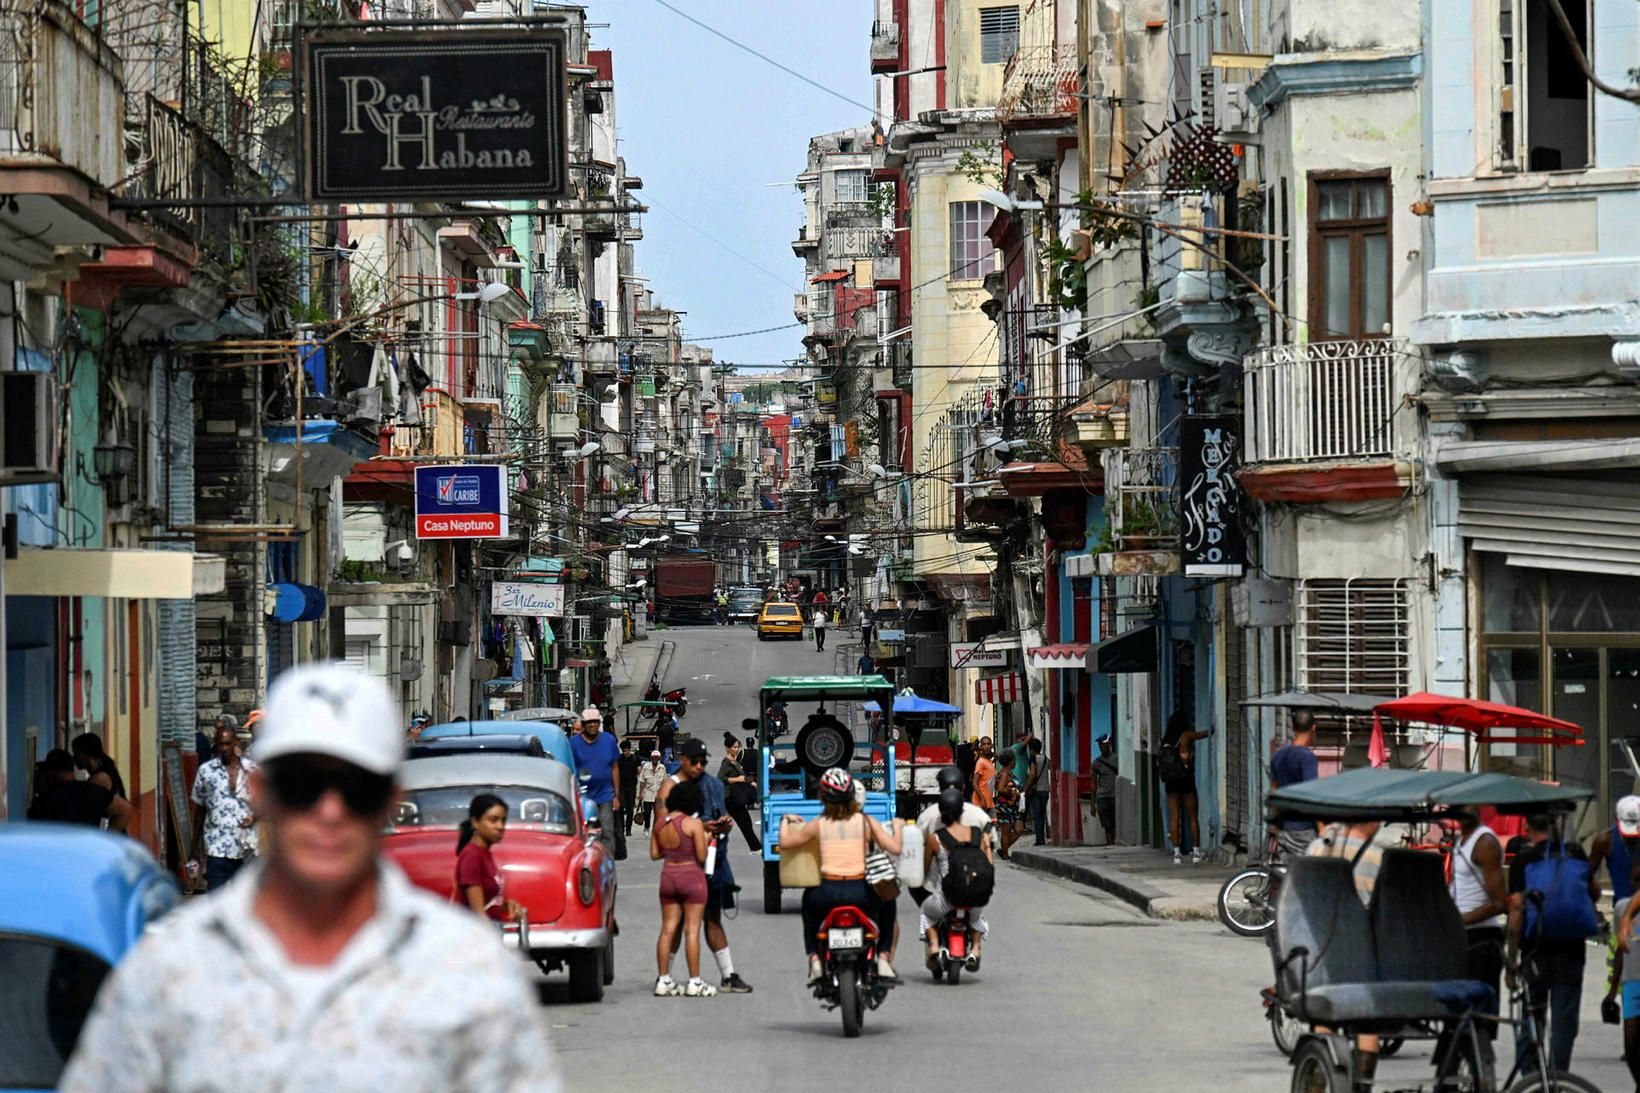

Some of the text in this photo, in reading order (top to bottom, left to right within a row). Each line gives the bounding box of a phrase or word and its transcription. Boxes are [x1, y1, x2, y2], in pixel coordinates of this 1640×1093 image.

[339, 75, 433, 134] Real
[436, 105, 535, 130] Restaurante
[381, 111, 534, 170] Habana
[453, 489, 479, 502] CARIBE
[1203, 428, 1223, 563] MERCADO
[424, 519, 495, 533] Casa Neptuno
[500, 593, 555, 609] Milenio
[972, 653, 1002, 661] NEPTUNO
